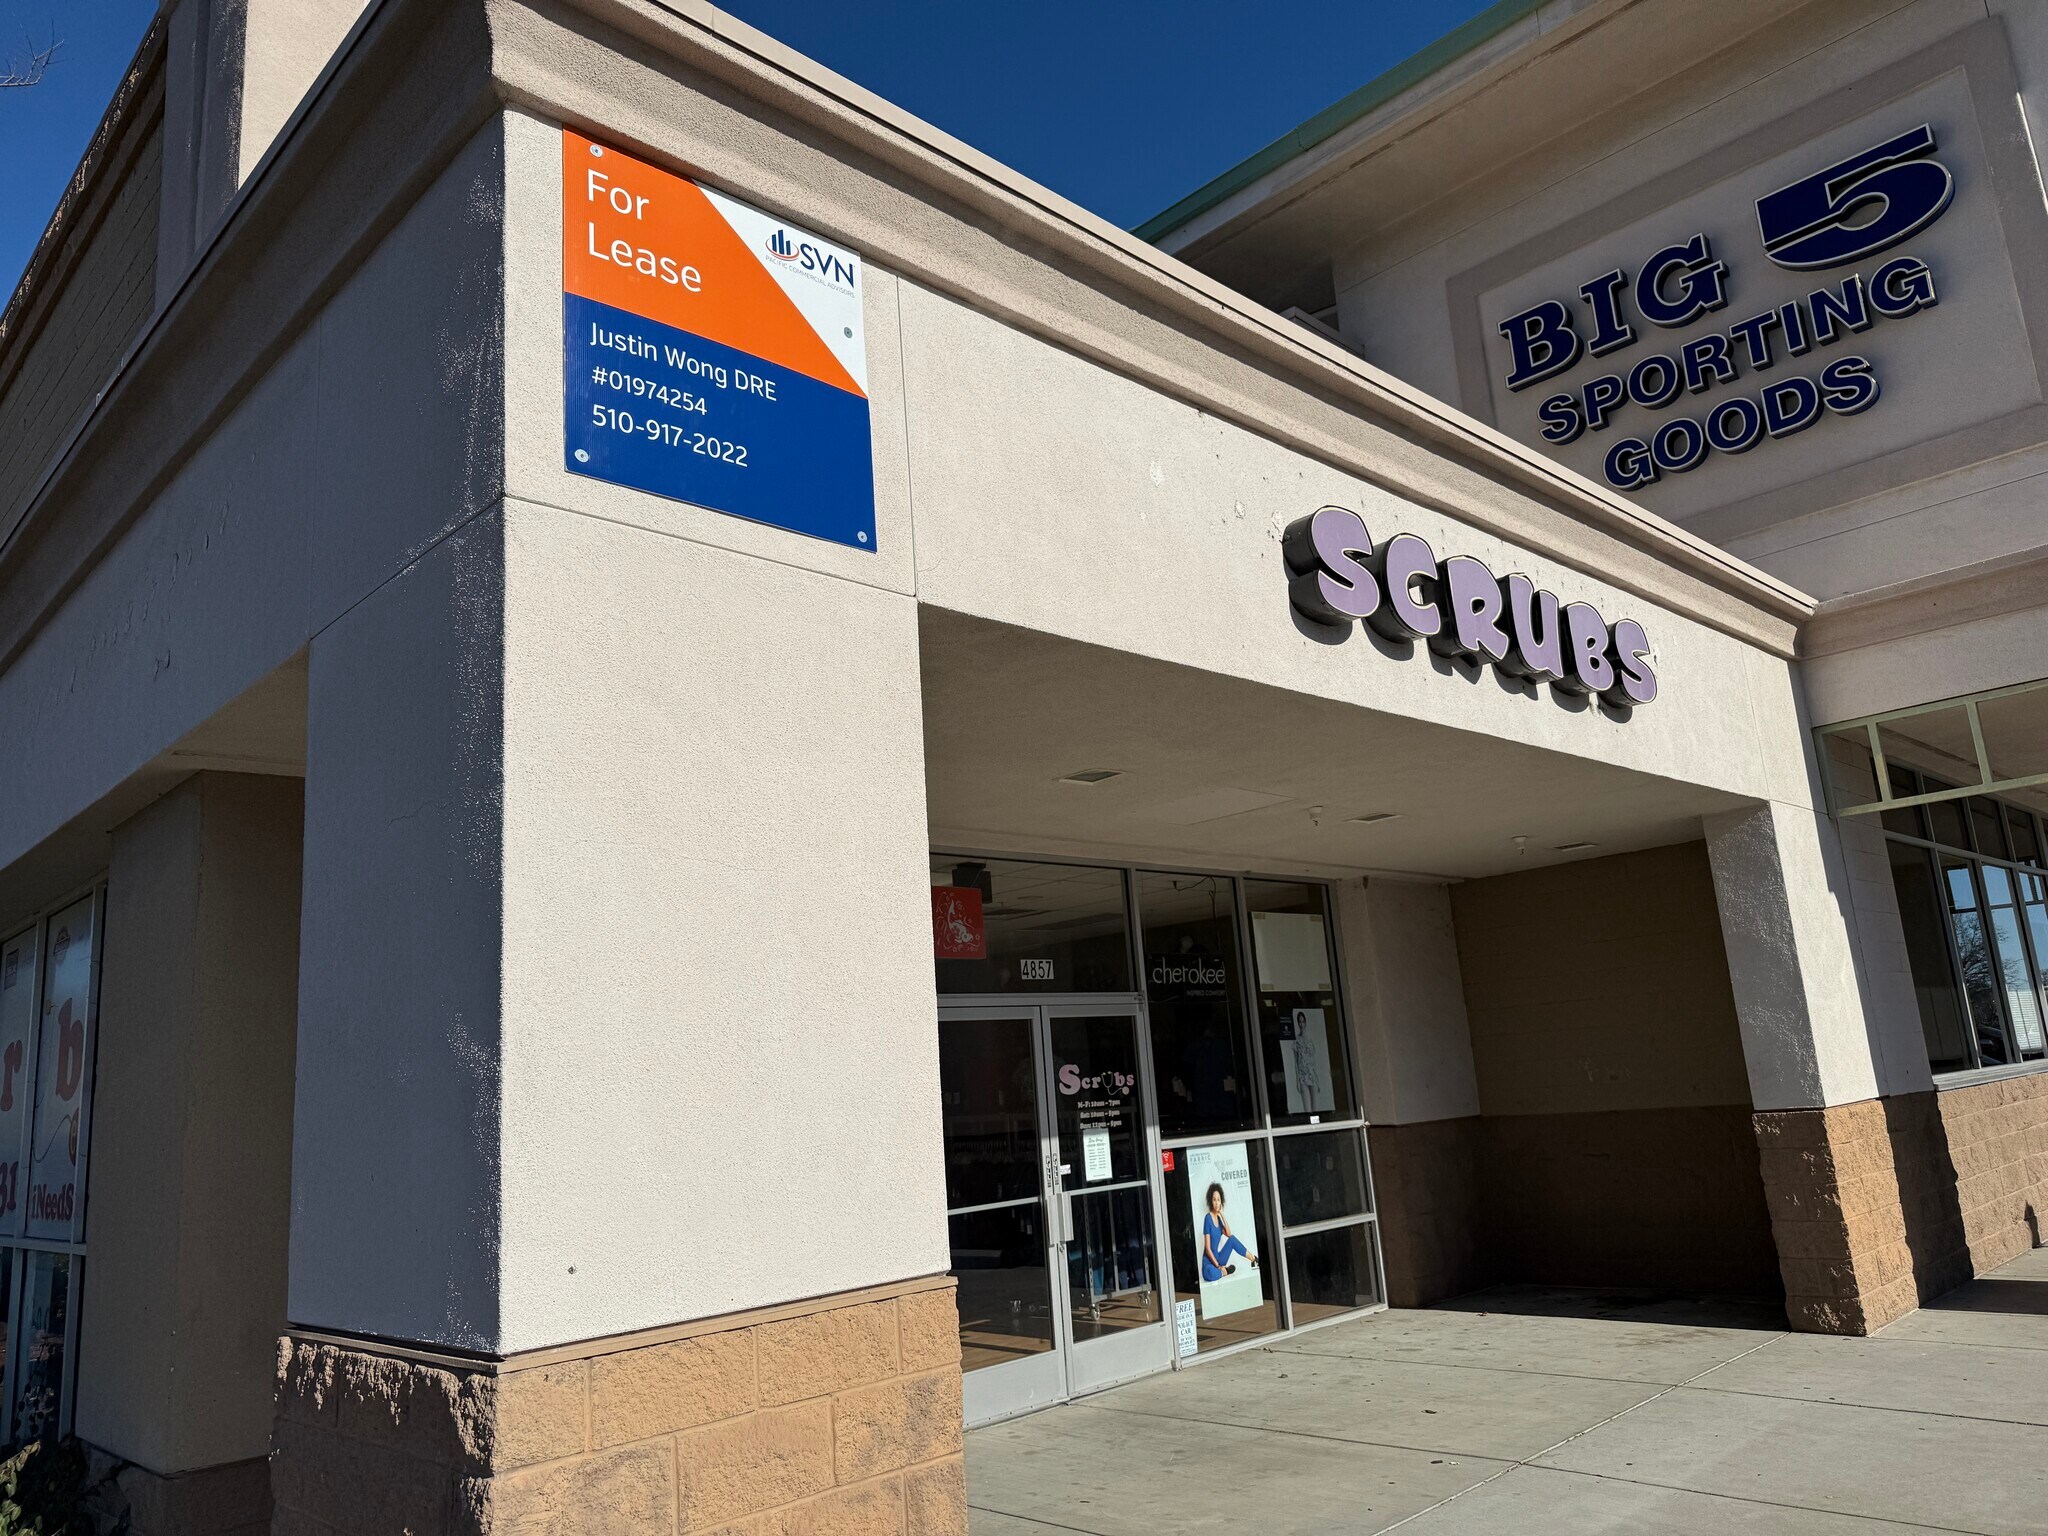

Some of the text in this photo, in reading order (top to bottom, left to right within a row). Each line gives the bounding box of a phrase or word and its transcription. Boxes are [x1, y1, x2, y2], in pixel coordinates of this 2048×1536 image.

[588, 168, 650, 220] For
[588, 221, 702, 293] Lease
[800, 243, 854, 289] SVN
[1498, 122, 1955, 391] BIG 5
[590, 322, 777, 401] Justin Wong DRE
[1537, 255, 1938, 446] SPORTING
[592, 366, 708, 415] #01974254
[592, 404, 748, 467] 510-917-2022
[1603, 355, 1880, 492] GOODS
[1284, 505, 1657, 705] SCRUBS
[1022, 960, 1052, 979] 4857
[1152, 955, 1226, 984] cherokee
[1221, 1168, 1248, 1181] COVERED
